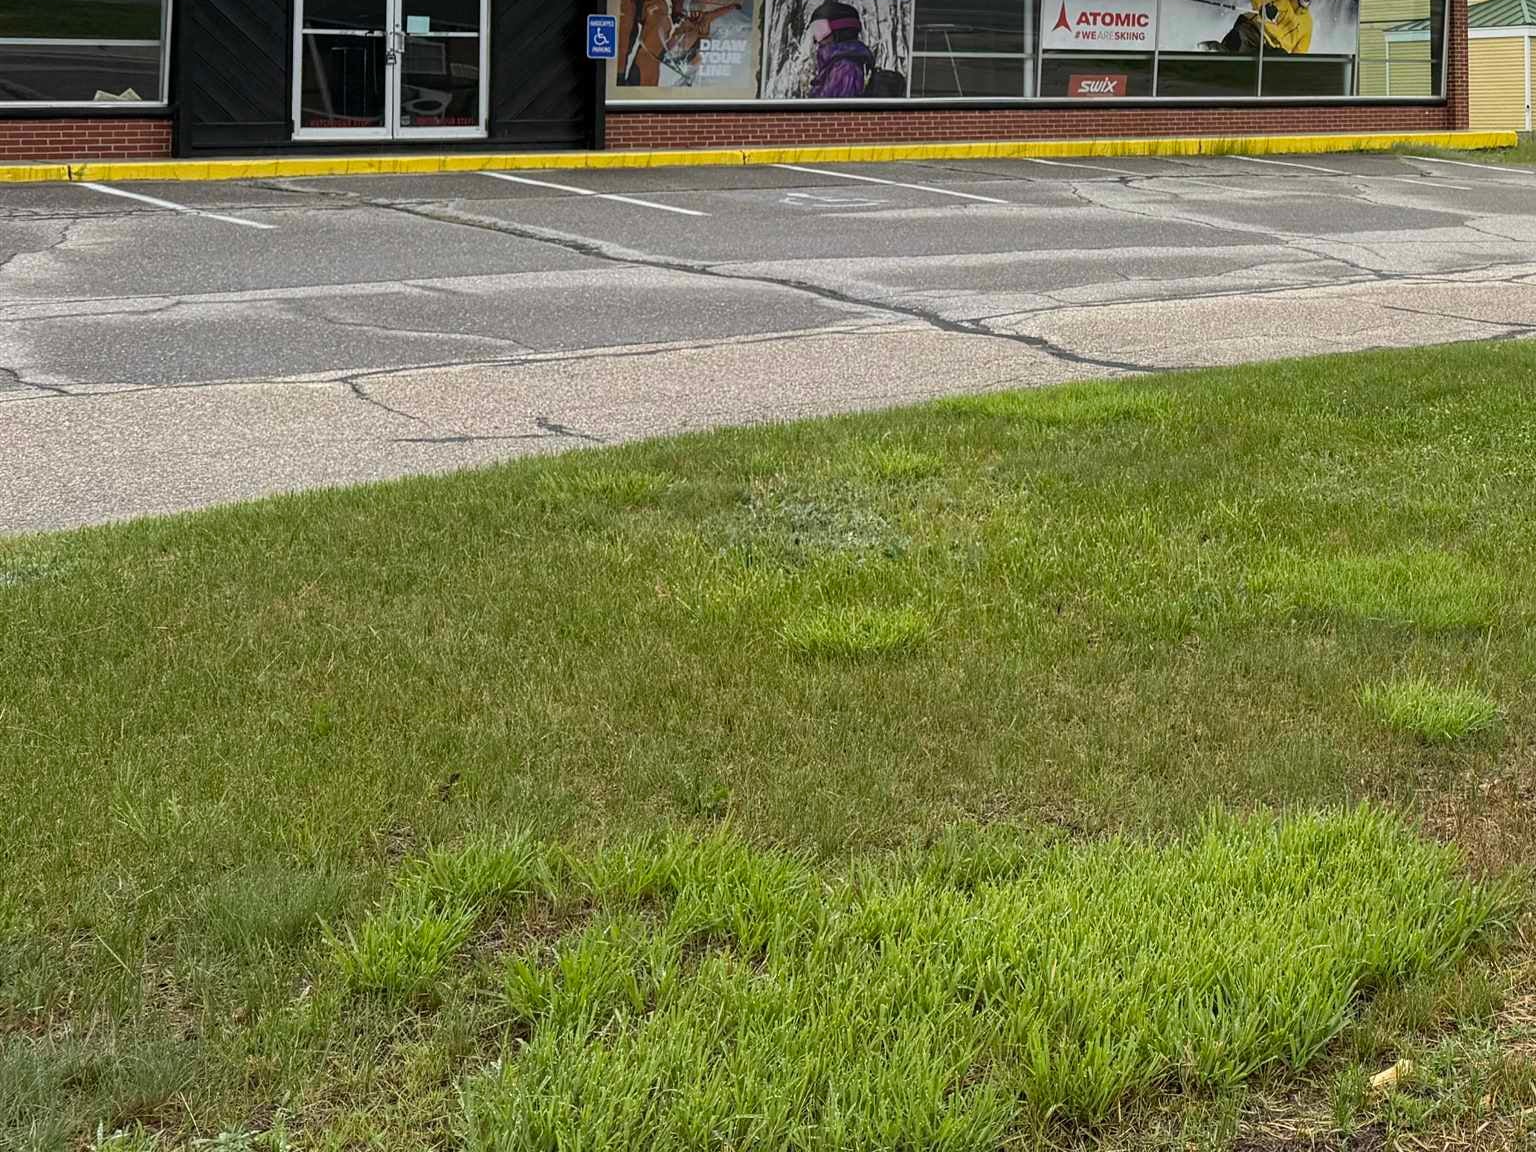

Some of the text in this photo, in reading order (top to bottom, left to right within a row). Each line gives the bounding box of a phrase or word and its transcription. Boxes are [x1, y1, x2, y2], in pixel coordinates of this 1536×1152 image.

[1076, 11, 1149, 27] ATOMIC
[700, 39, 748, 51] DRAW
[699, 51, 743, 65] YOUR
[700, 64, 730, 77] LINE
